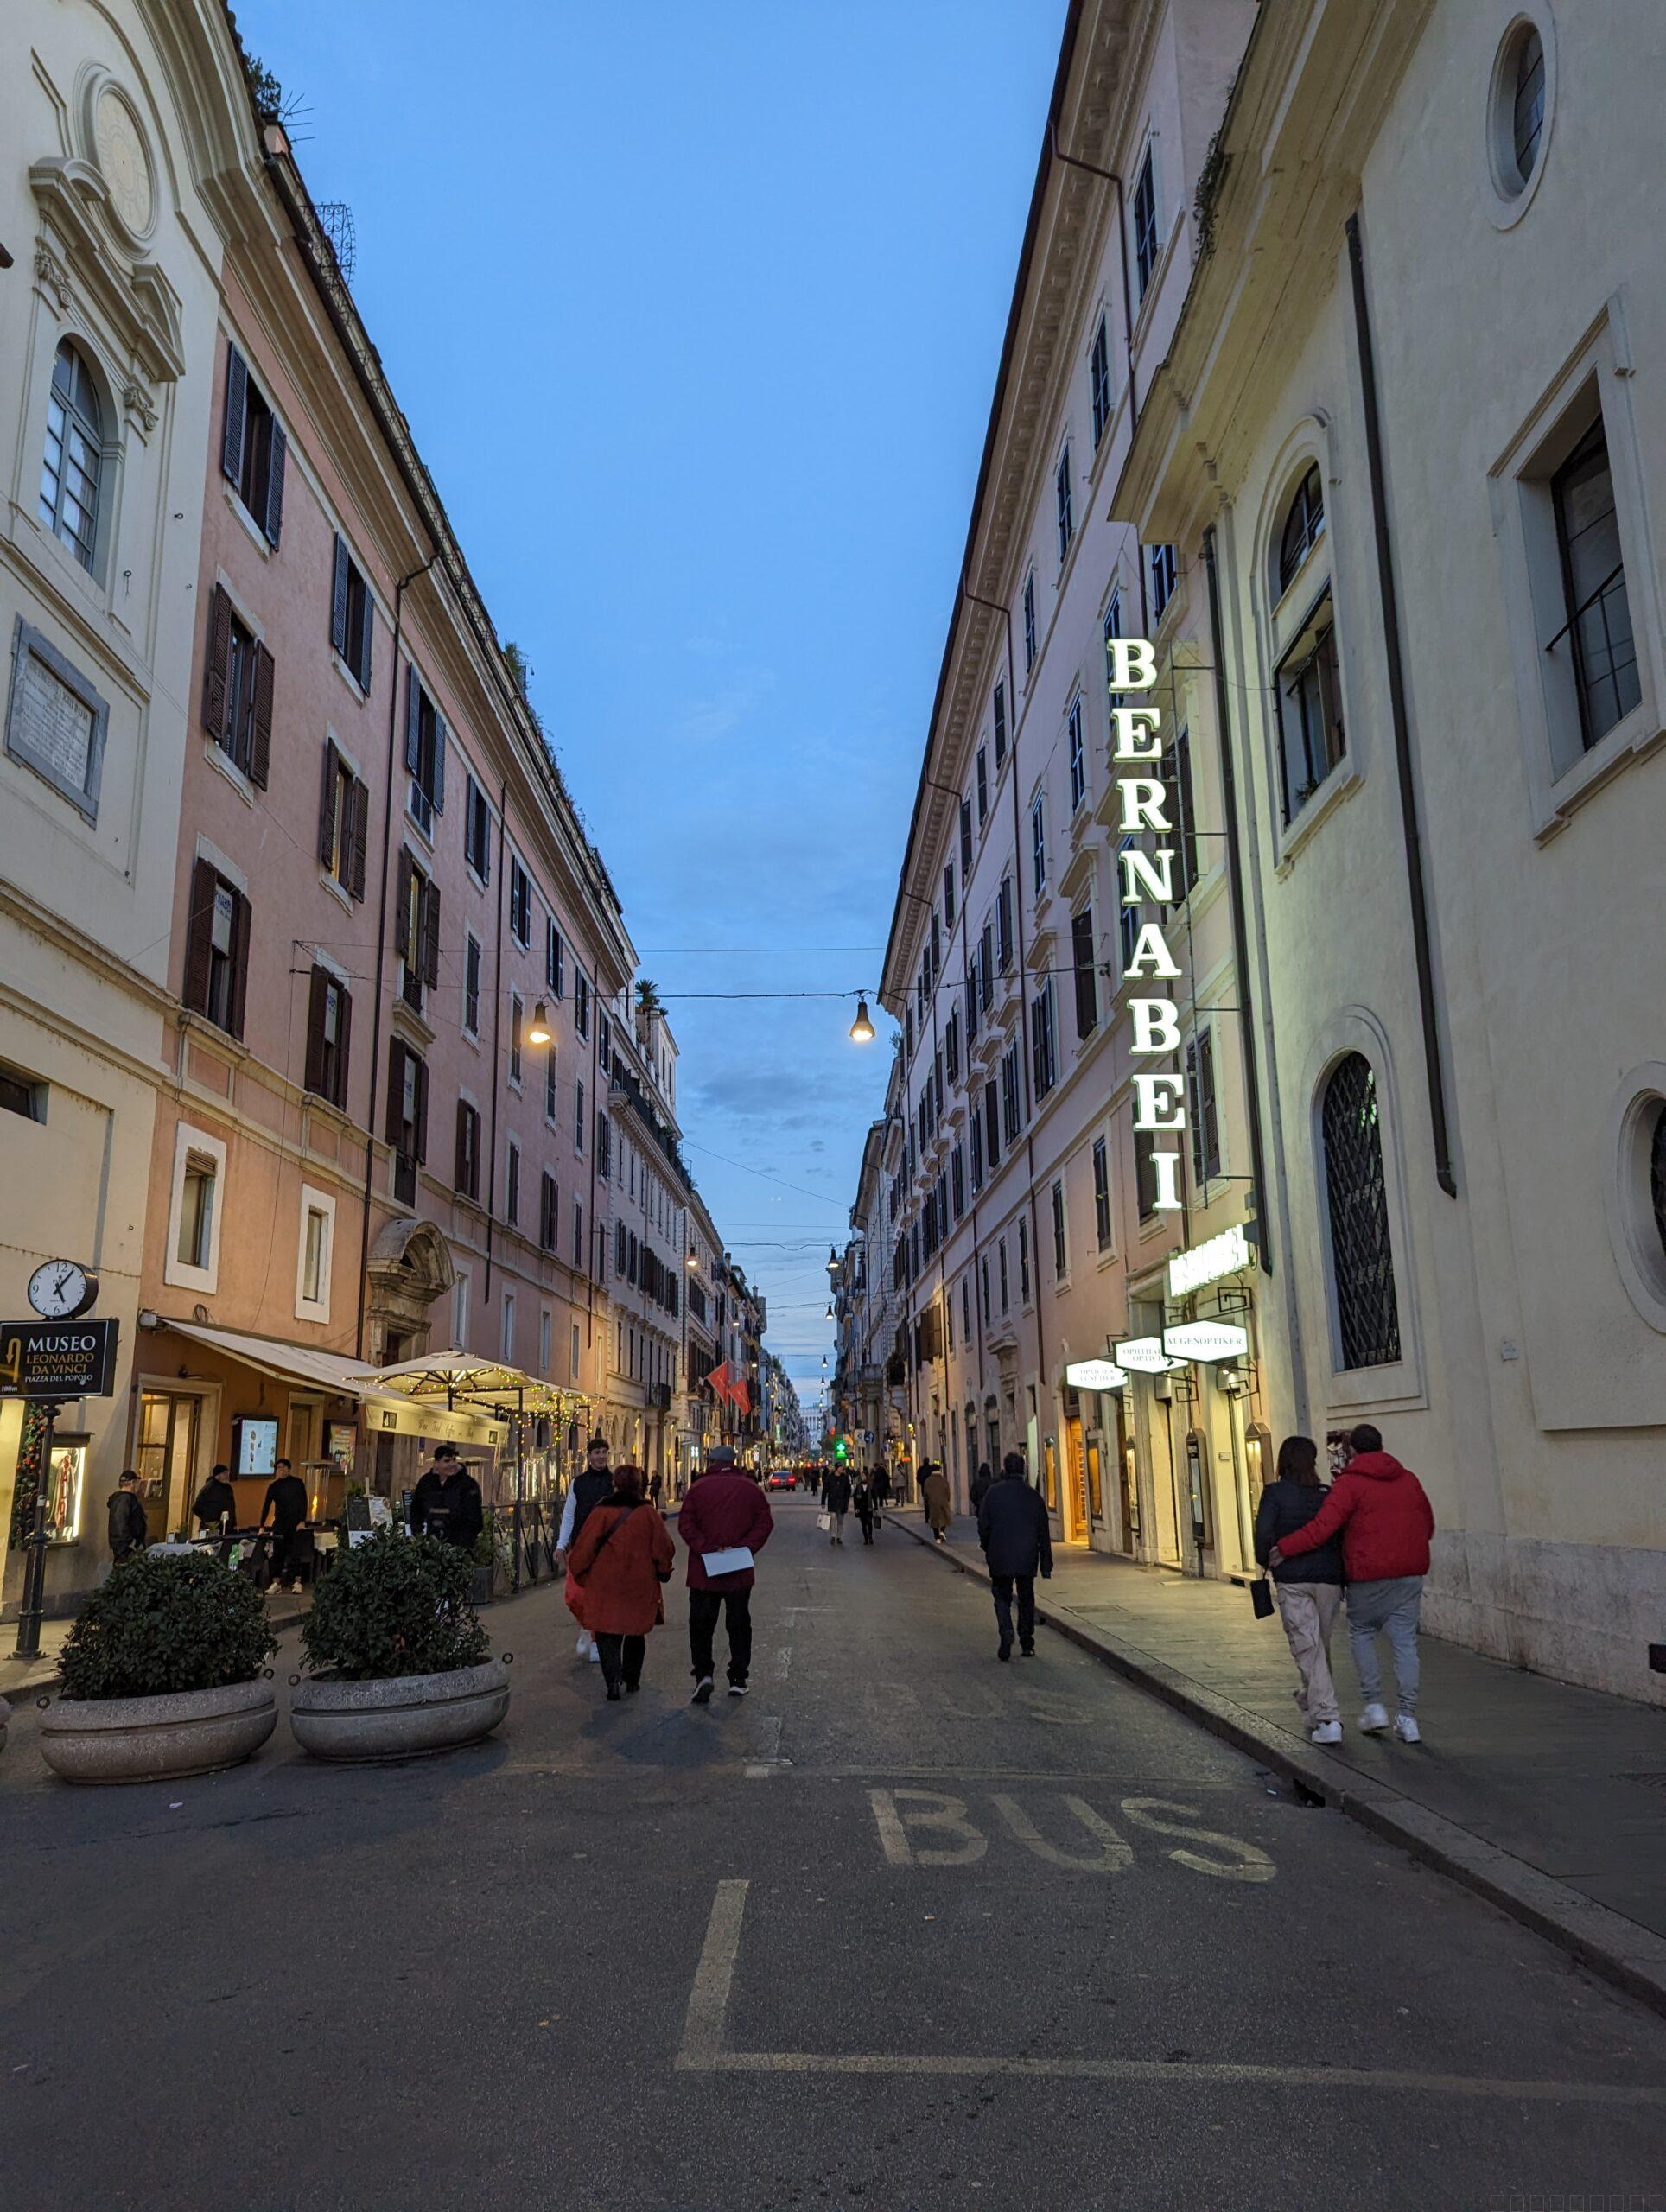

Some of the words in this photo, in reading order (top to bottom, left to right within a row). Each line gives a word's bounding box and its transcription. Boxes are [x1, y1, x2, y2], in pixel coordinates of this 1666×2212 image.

[1107, 637, 1186, 1211] BERNABEI
[56, 1262, 67, 1273] 12
[33, 1285, 40, 1294] 9
[54, 1306, 60, 1315] 6
[27, 1335, 96, 1352] MUSEO
[1166, 1337, 1243, 1345] AUGENOPTIKER
[26, 1352, 95, 1364] LEONARDO
[32, 1364, 49, 1375] DA
[52, 1363, 87, 1374] VINCI
[65, 1374, 93, 1382] POPOLO
[865, 1787, 1278, 1883] BUS
